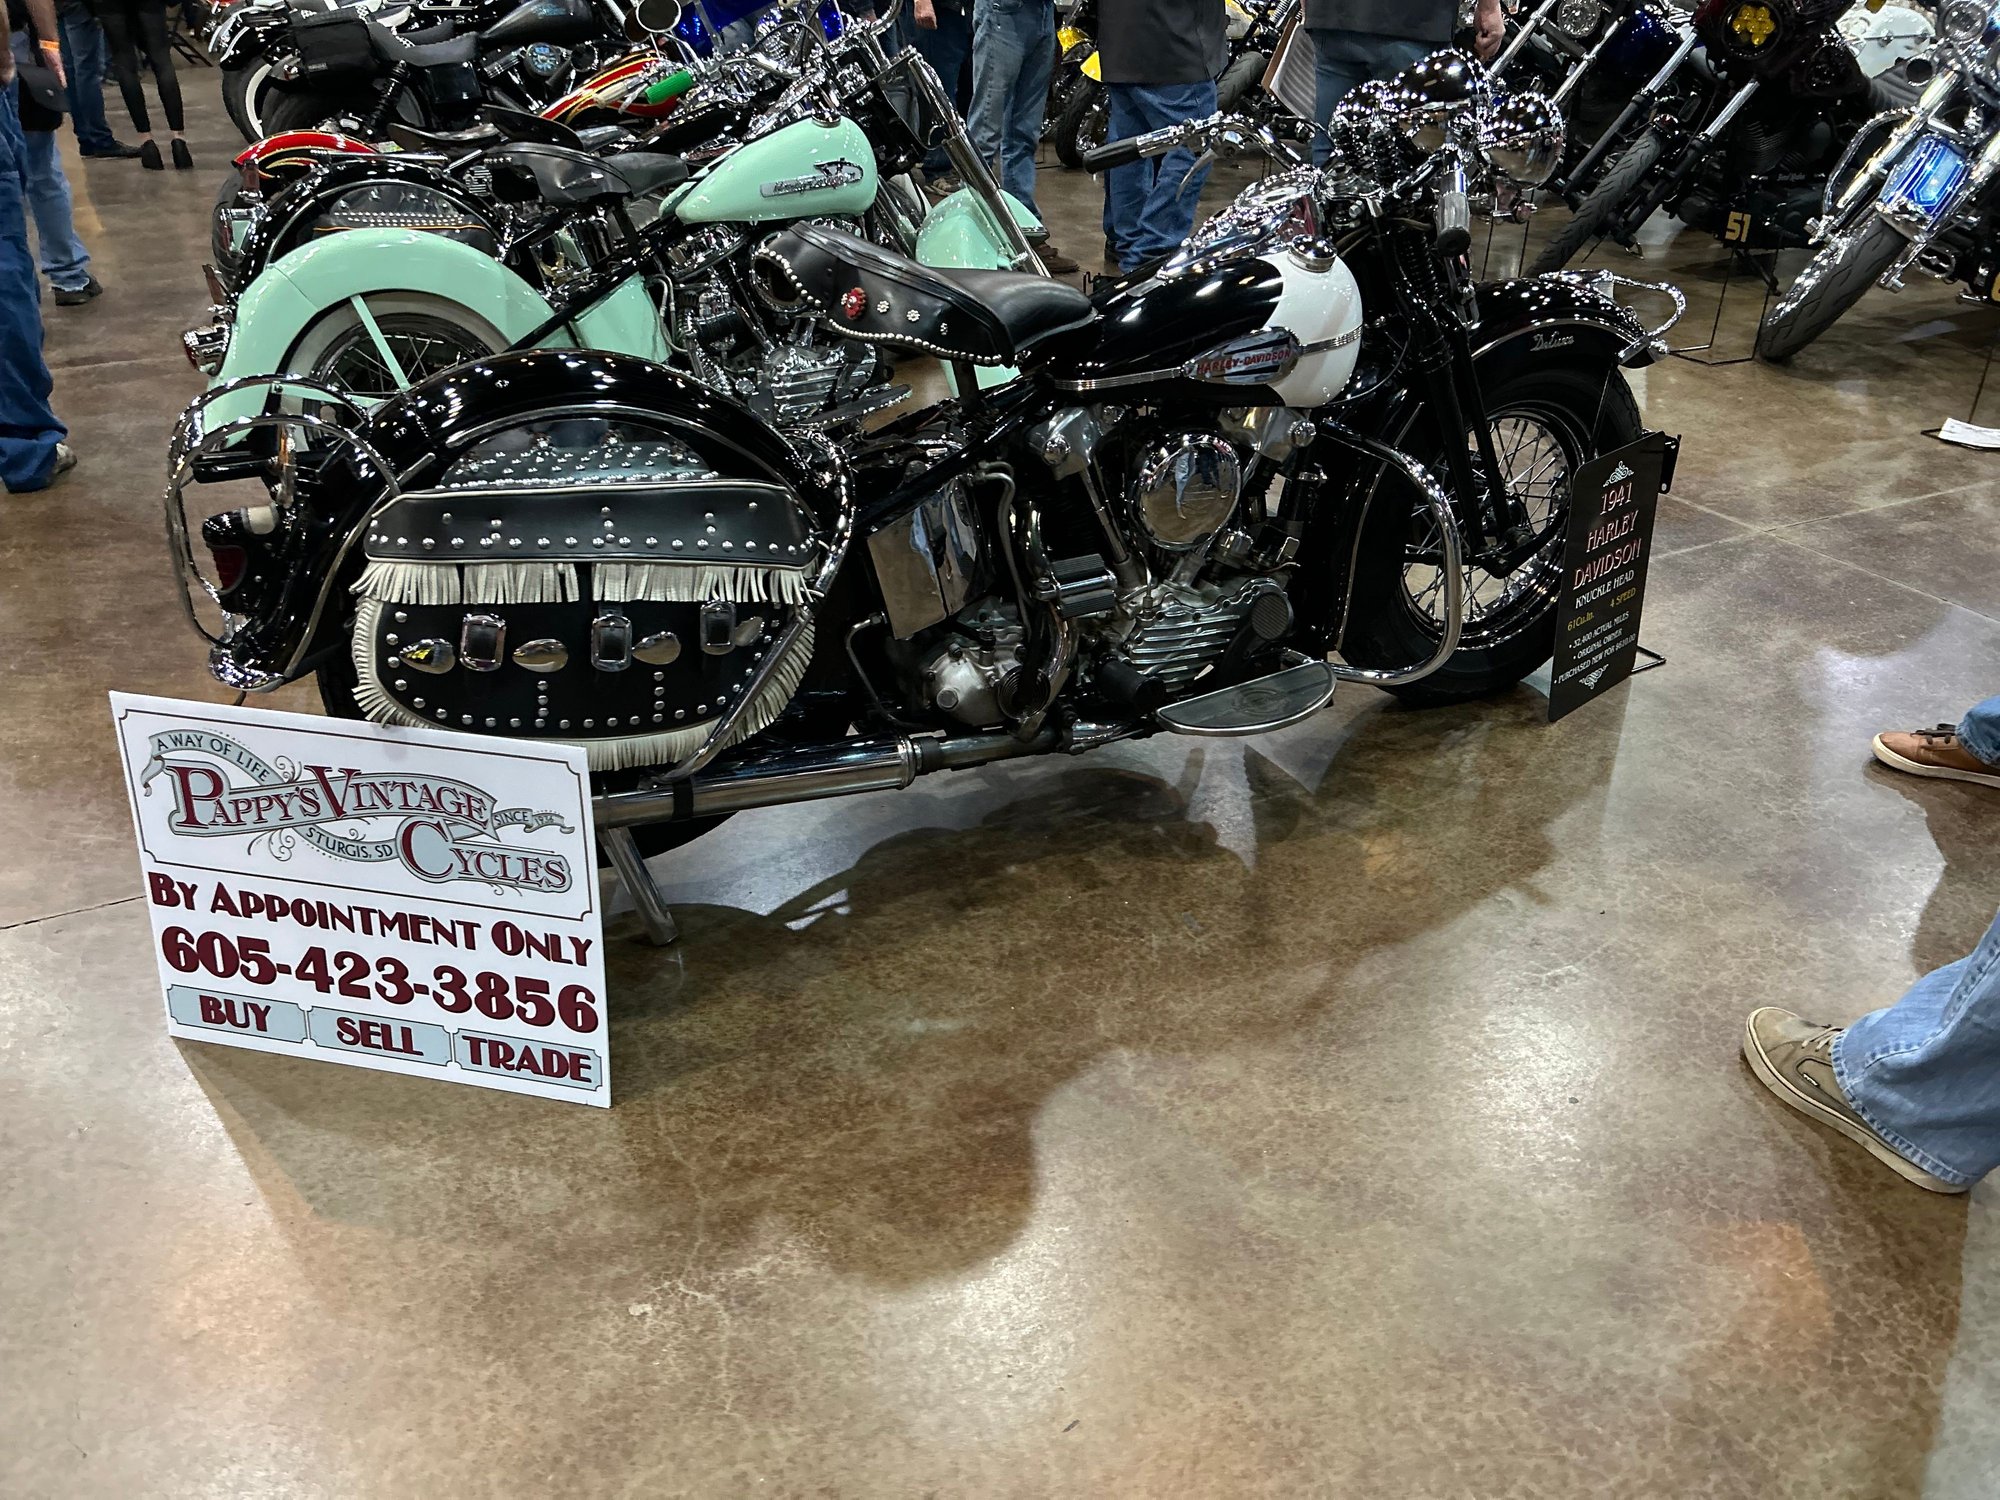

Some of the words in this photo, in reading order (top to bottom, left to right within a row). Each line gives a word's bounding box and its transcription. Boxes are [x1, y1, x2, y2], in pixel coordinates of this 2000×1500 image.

[1725, 211, 1751, 242] 51
[1197, 349, 1290, 374] HARLEY-DAVIDSON
[1600, 482, 1633, 515] 1941
[1586, 510, 1639, 553] HARLEY
[1573, 538, 1642, 590] DAVIDSON
[1576, 580, 1612, 609] KNUCKLE
[1613, 570, 1635, 589] HEAD
[1616, 587, 1637, 606] SPEED
[1577, 640, 1602, 659] ORIGINAL
[1603, 628, 1623, 645] OWNER
[1593, 620, 1613, 638] ACTUAL
[1613, 611, 1630, 627] MILES
[1558, 659, 1591, 684] PURCHASED
[1591, 652, 1604, 665] NEW
[1604, 645, 1615, 658] FOR
[157, 738, 168, 751] A
[168, 734, 203, 748] WAY
[210, 738, 232, 756] OF
[236, 752, 270, 783] LIFE
[165, 764, 321, 830] PAPPY'S
[304, 765, 489, 829] VINTAGE
[494, 811, 529, 826] SINCE
[306, 827, 372, 859] STURGIS,
[376, 845, 393, 857] SD
[401, 819, 568, 888] CYCLES
[148, 871, 199, 910] BY
[210, 882, 481, 951] APPOINTMENT
[491, 921, 593, 967] ONLY
[161, 926, 599, 1034] 605-423-3856
[199, 994, 271, 1033] BUY
[336, 1017, 424, 1057] SELL
[462, 1035, 593, 1083] TRADE
